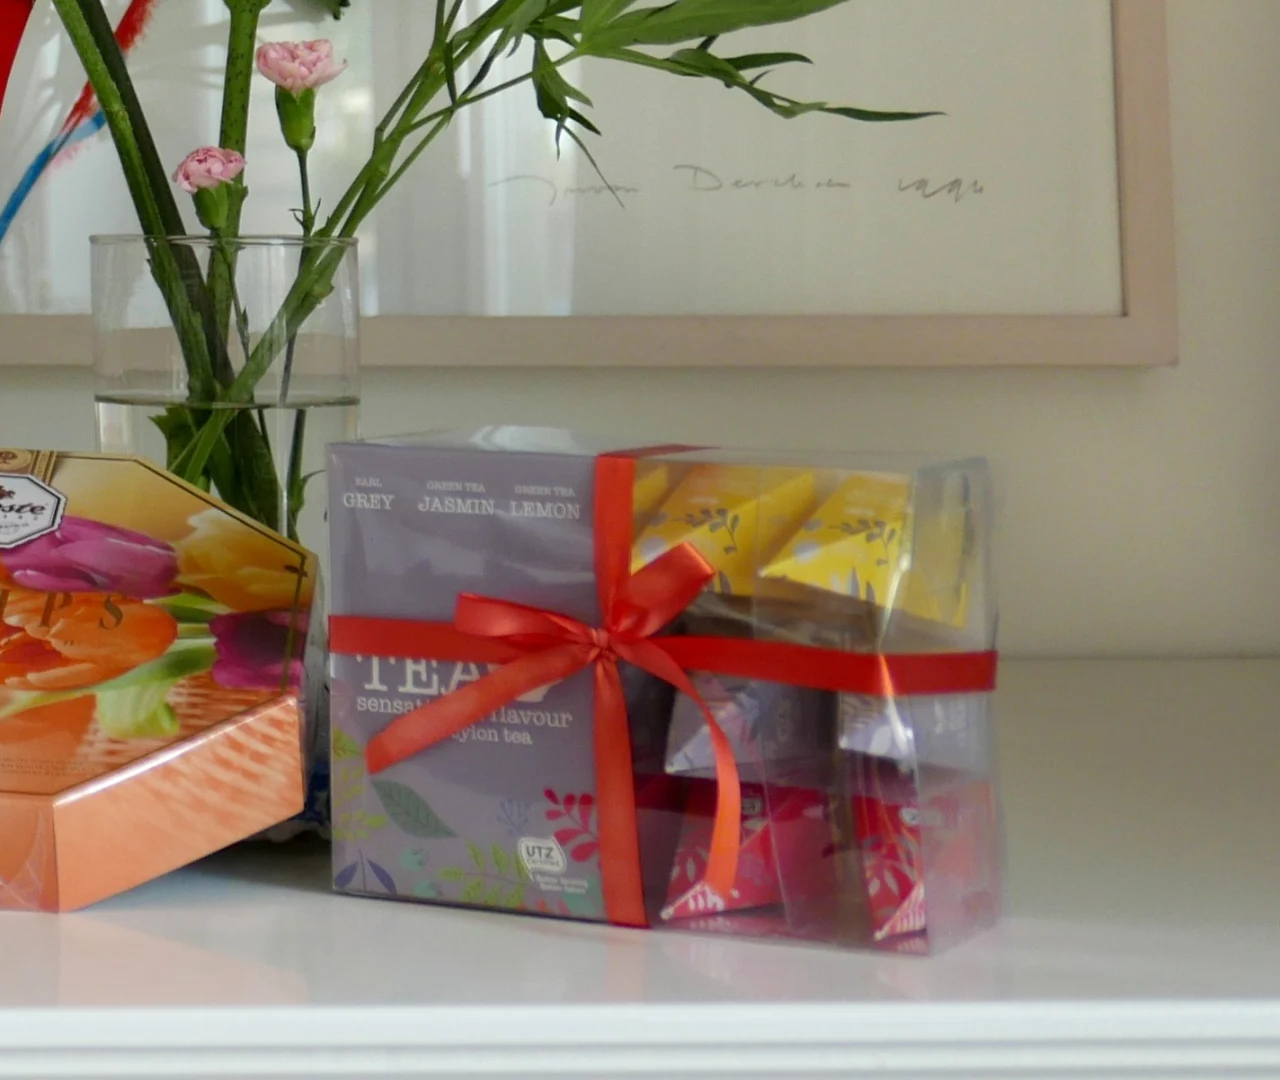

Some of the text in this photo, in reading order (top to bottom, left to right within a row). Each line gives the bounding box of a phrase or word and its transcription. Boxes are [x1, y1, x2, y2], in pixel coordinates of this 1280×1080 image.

[354, 477, 383, 489] EARL
[343, 492, 396, 511] GREY
[418, 496, 496, 516] JASMIN
[510, 501, 582, 520] LEMON
[504, 728, 533, 745] tea
[525, 845, 554, 859] UTZ
